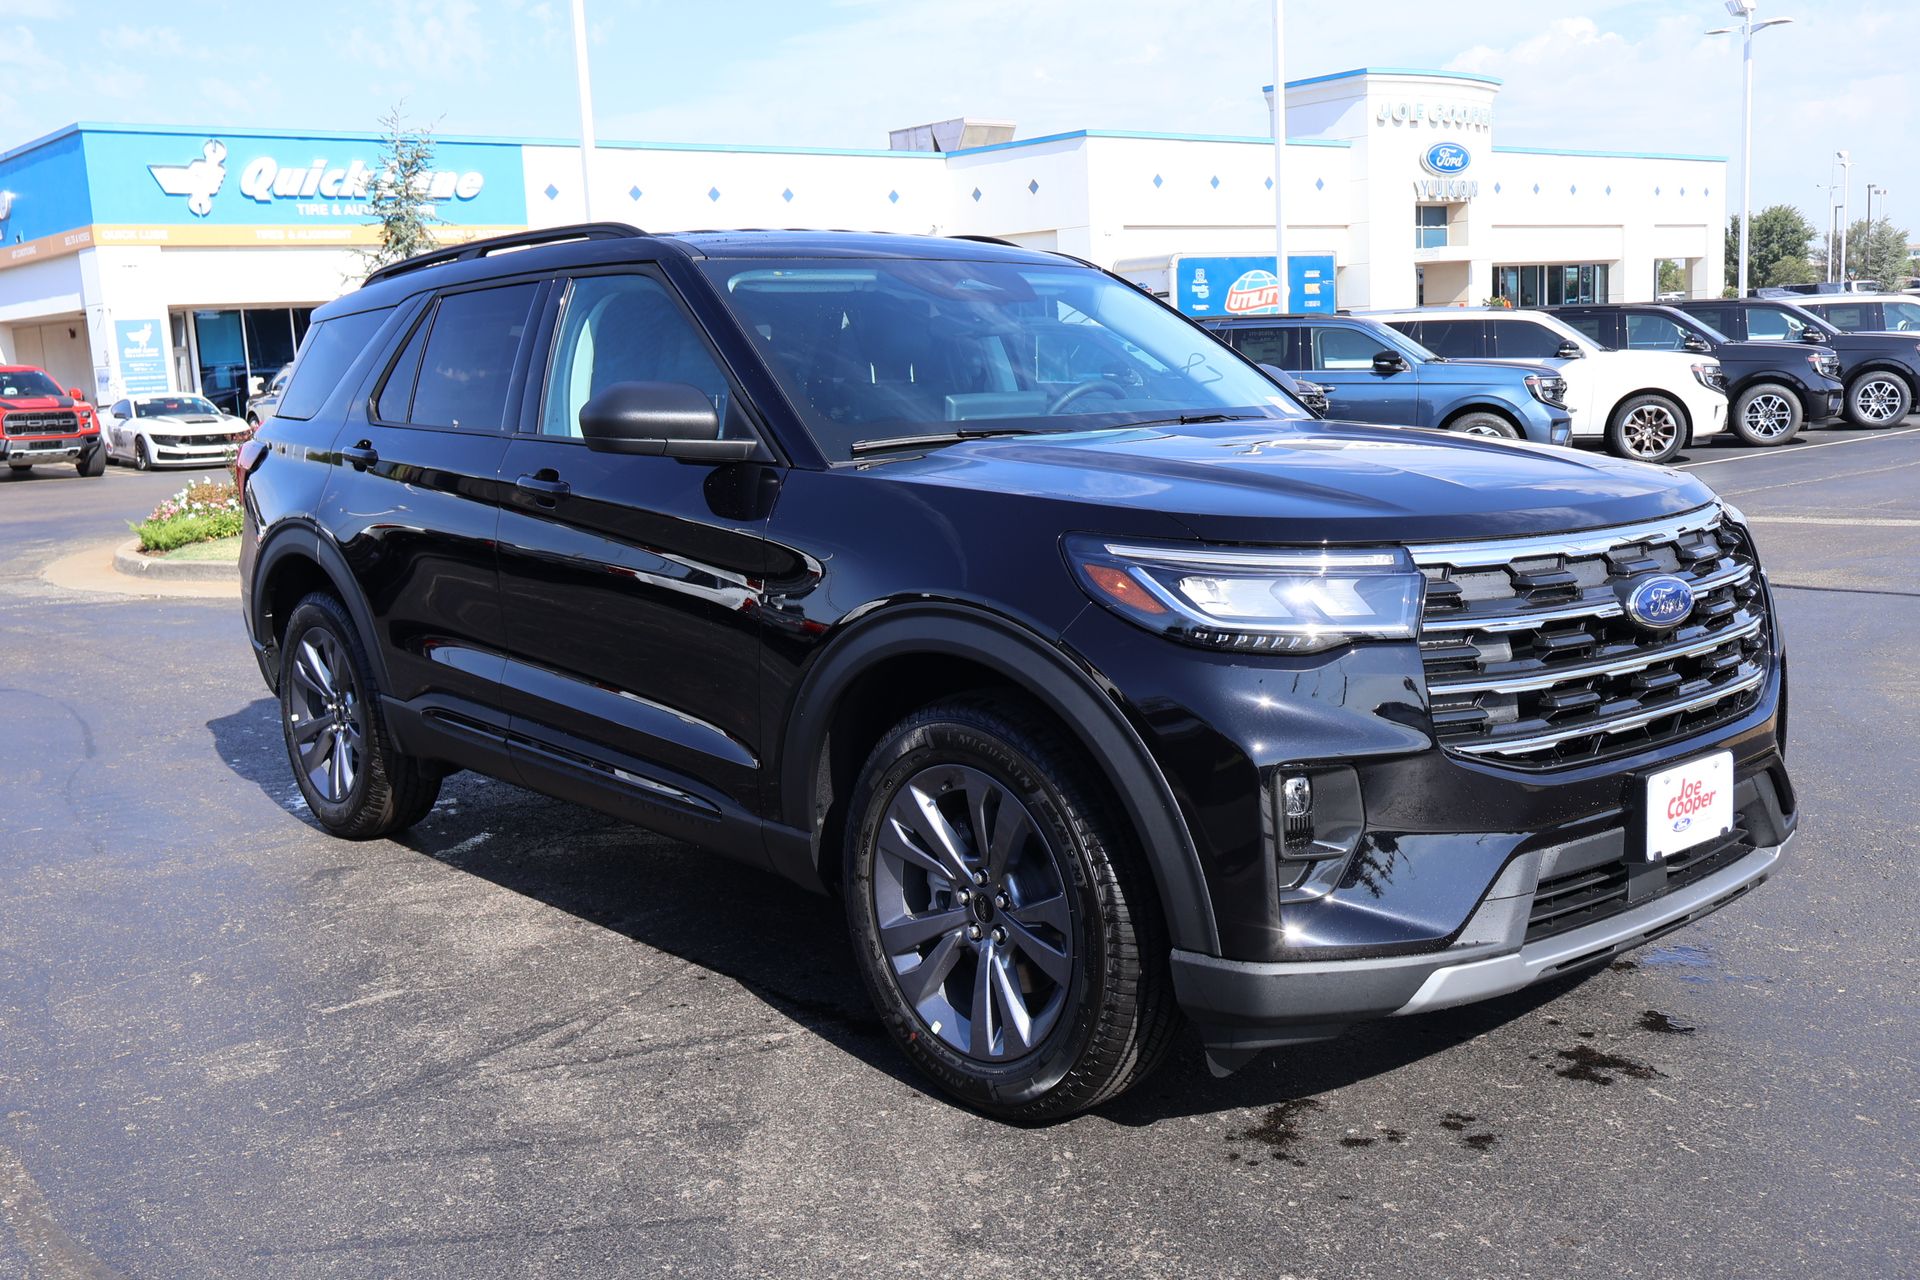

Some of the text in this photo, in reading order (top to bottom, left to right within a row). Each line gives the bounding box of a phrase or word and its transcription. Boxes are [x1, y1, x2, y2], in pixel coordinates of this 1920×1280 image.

[1378, 102, 1424, 125] JOE
[1435, 146, 1464, 168] Ford
[239, 156, 376, 204] Quick
[1417, 179, 1478, 201] YUKON
[296, 203, 329, 216] TIRE
[331, 203, 342, 216] &
[1230, 287, 1278, 309] UTILIT
[9, 418, 75, 427] FORD
[1650, 586, 1685, 617] Ford
[1677, 778, 1703, 802] Joe
[1667, 790, 1717, 820] Cooper
